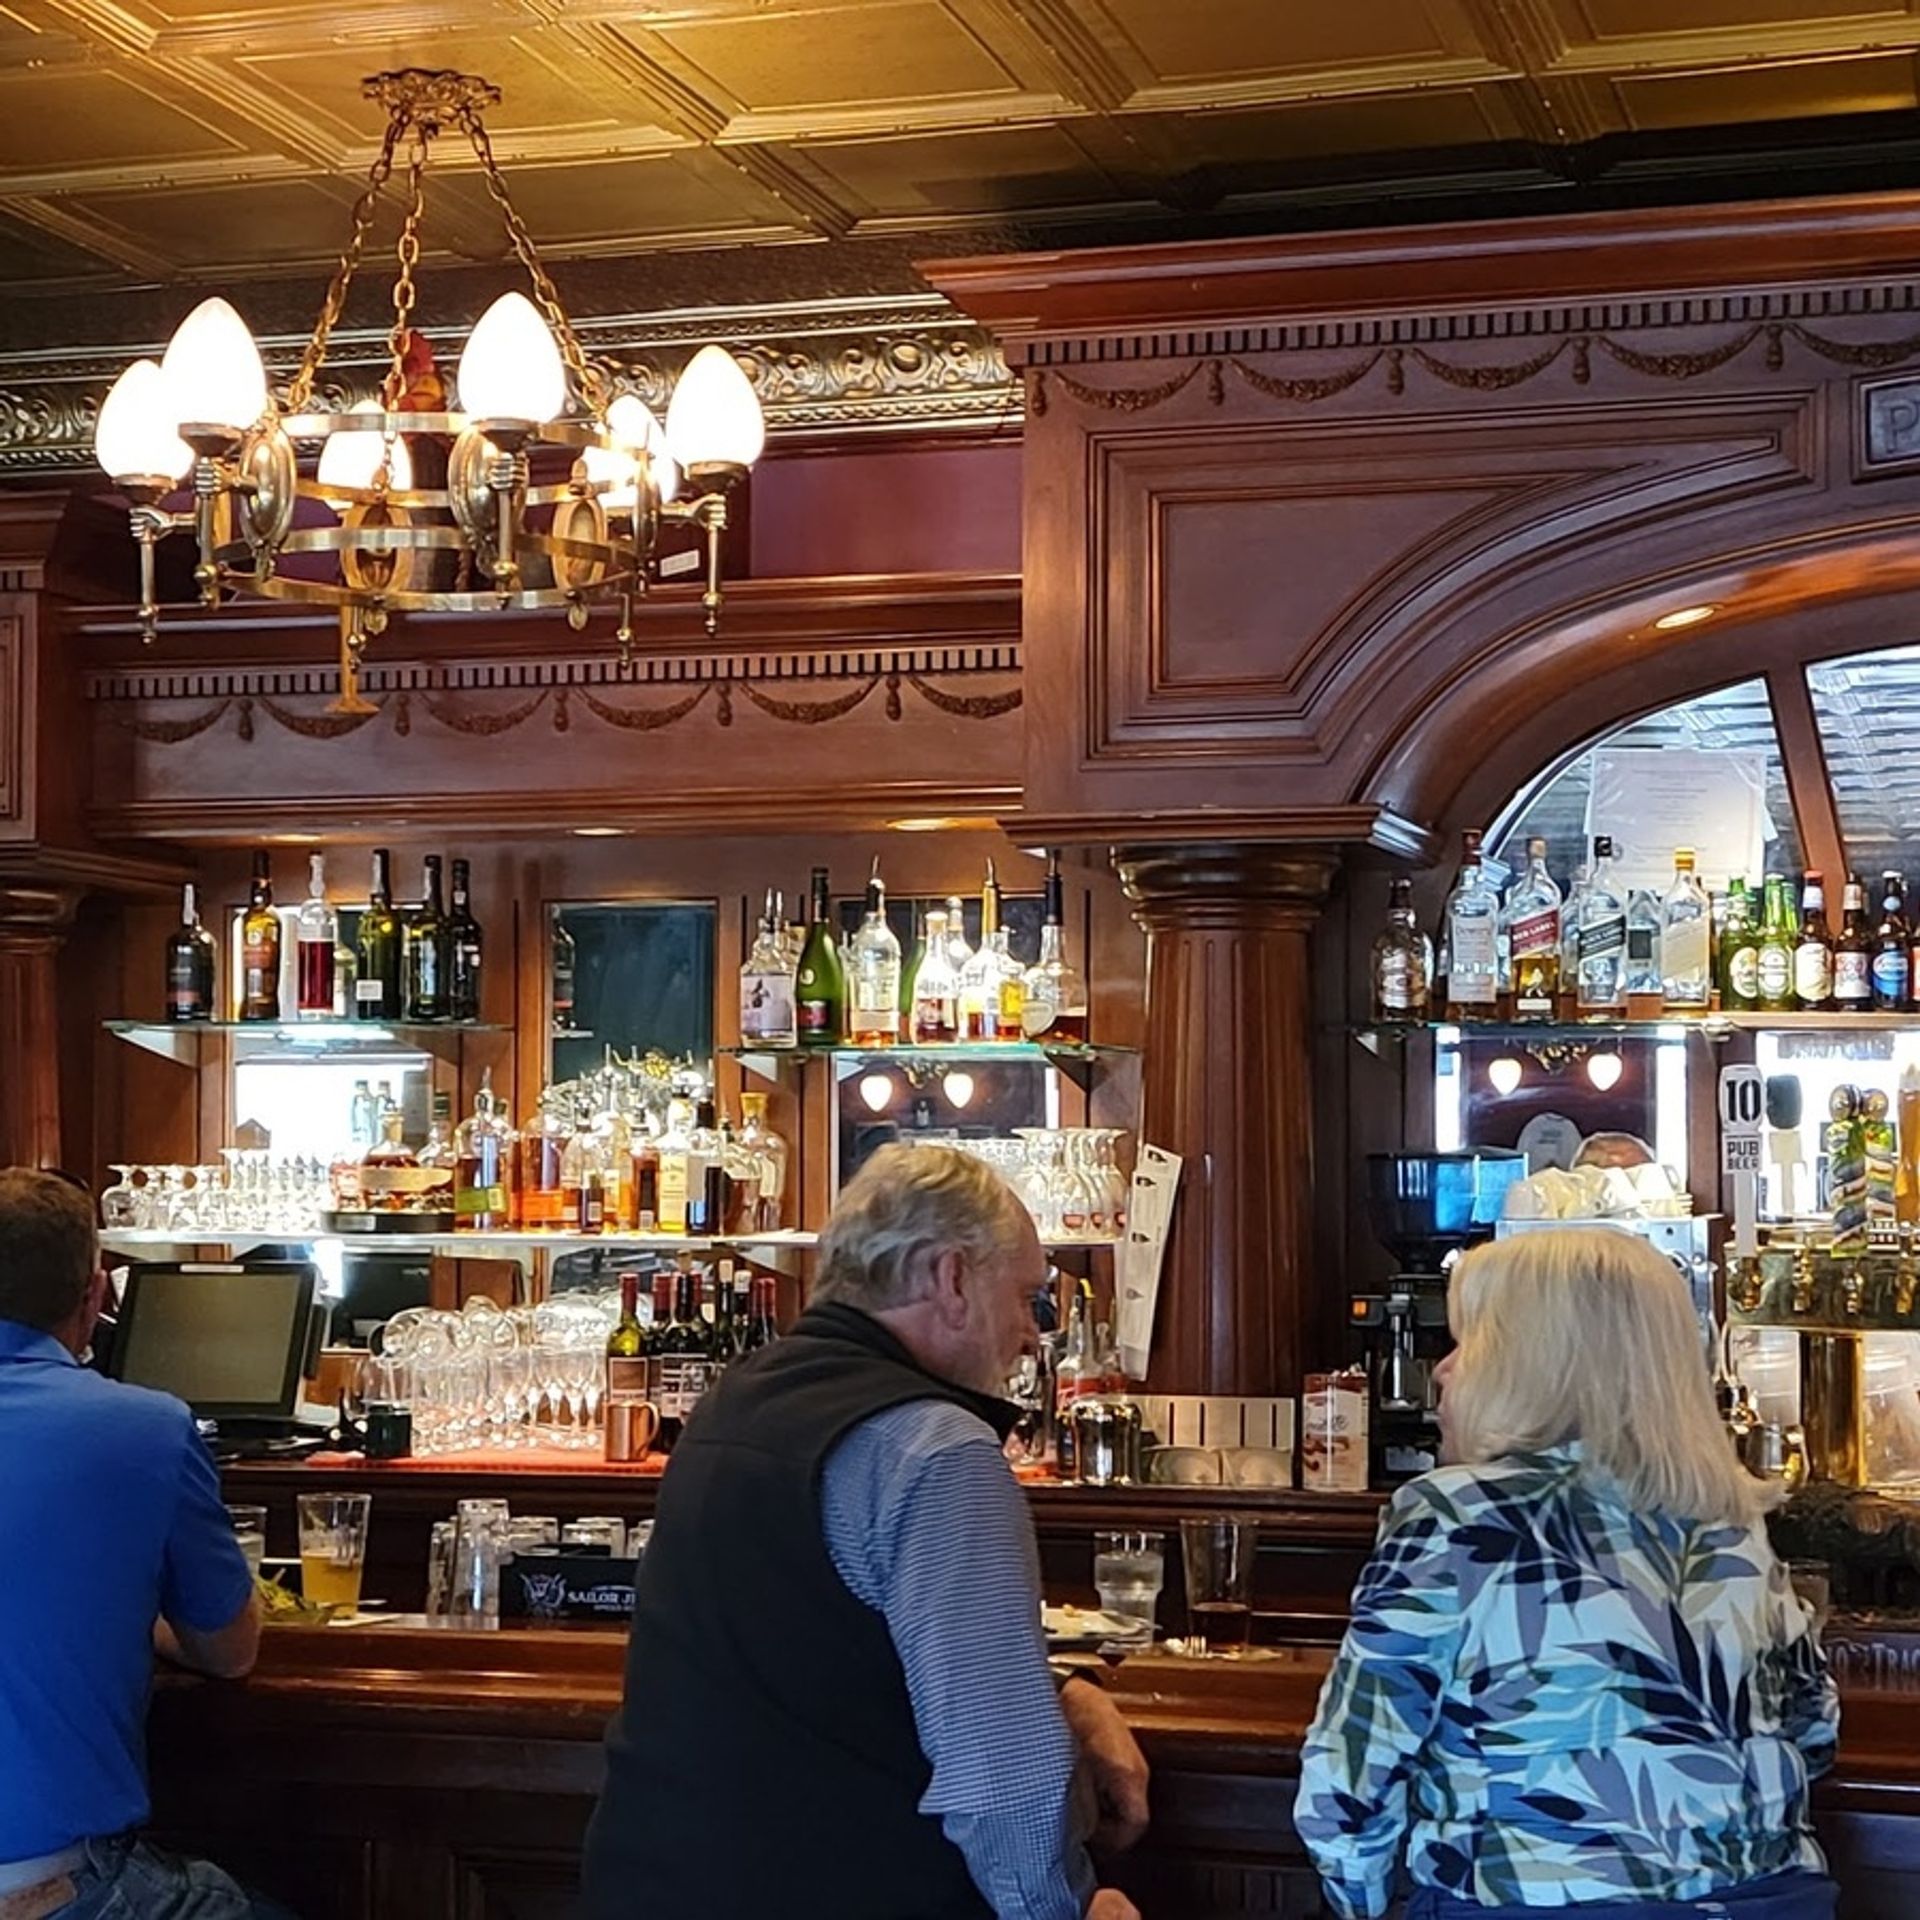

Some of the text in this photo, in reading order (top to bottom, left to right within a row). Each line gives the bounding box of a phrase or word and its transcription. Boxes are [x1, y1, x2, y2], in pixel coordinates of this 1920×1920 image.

[1726, 1079, 1762, 1122] 10
[1726, 1141, 1760, 1157] PUB
[1726, 1158, 1760, 1171] BEER
[567, 1590, 619, 1604] SAILOR
